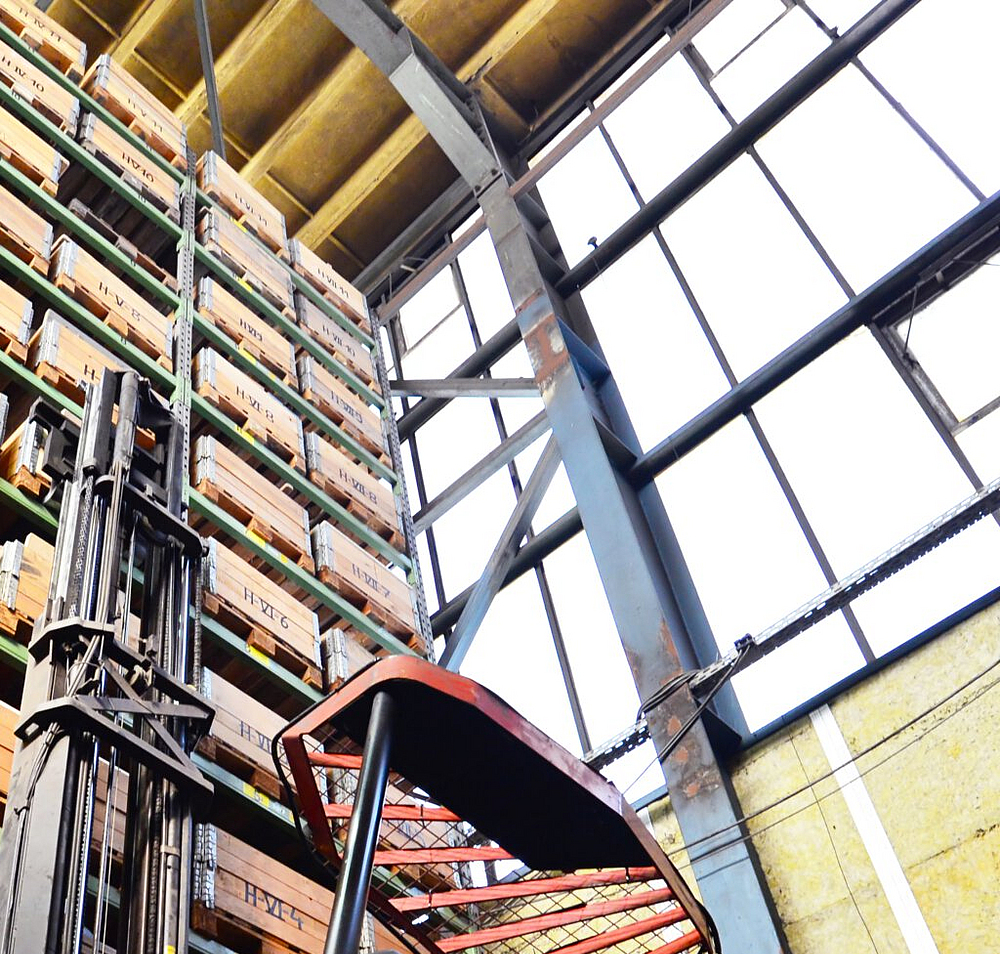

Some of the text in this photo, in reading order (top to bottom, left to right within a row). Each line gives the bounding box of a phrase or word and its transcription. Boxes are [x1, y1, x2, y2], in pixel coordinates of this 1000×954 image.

[98, 280, 142, 324] H-V-8
[235, 384, 275, 425] H-VI-8
[338, 468, 379, 506] H-VII-8
[351, 562, 392, 600] H-VII-7
[243, 586, 291, 630] H-VI-6
[245, 881, 304, 930] H-VI-4
